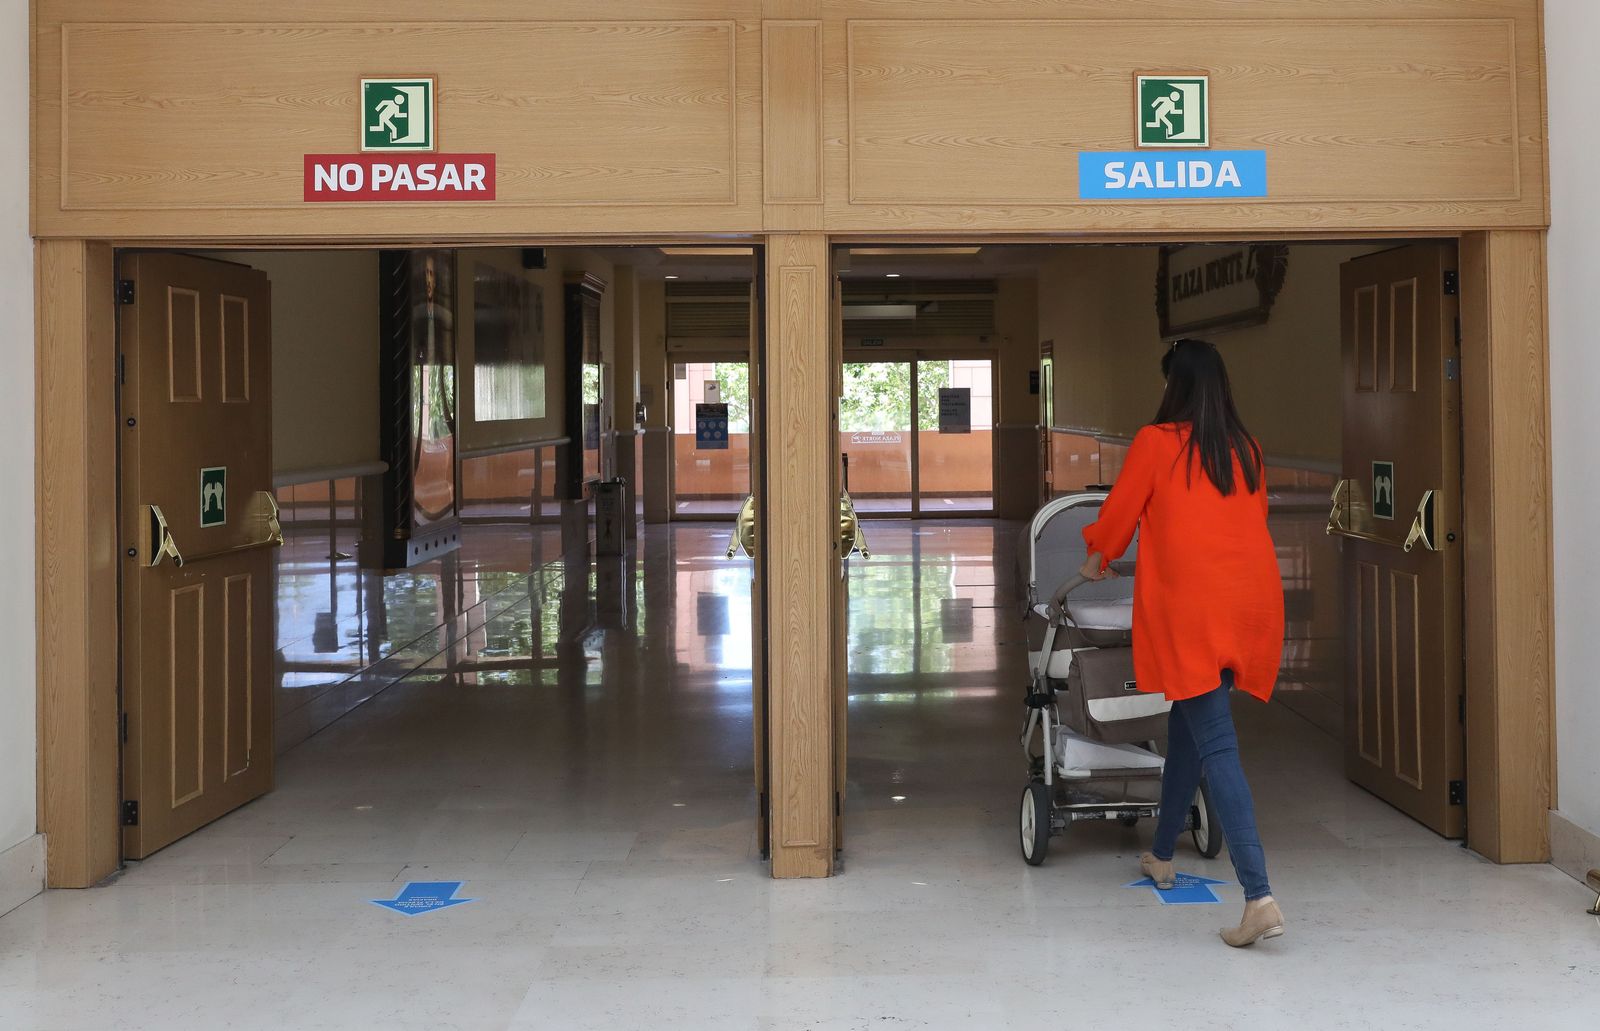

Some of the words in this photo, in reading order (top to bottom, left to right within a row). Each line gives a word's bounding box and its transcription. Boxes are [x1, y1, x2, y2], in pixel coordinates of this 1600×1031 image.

[314, 163, 363, 192] NO
[371, 163, 486, 191] PASAR
[1104, 160, 1242, 189] SALIDA
[1172, 266, 1204, 302] PLAZA
